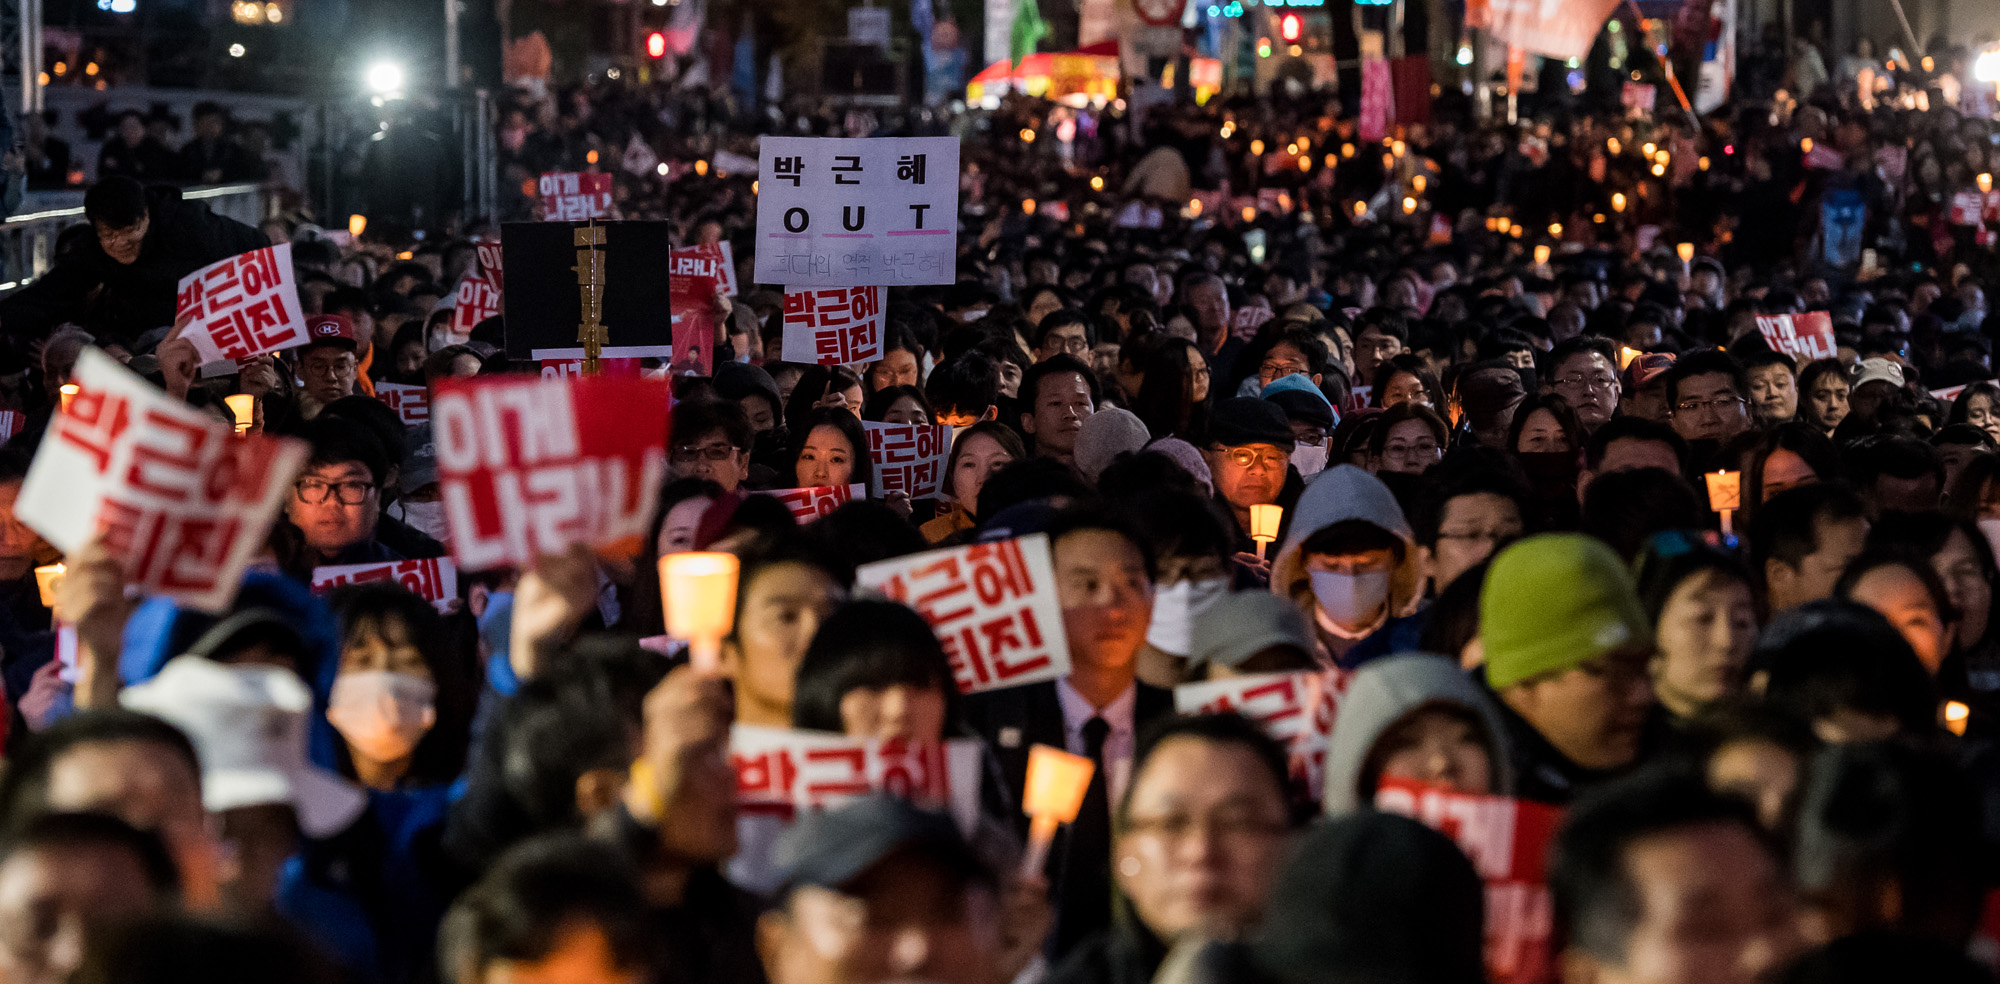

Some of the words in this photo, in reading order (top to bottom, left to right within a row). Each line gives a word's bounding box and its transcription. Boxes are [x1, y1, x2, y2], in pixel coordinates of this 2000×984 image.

[540, 174, 580, 196] 이게
[176, 246, 282, 322] 박근혜
[883, 252, 945, 279] 박근혜
[206, 292, 297, 360] 퇴진
[785, 286, 879, 328] 박근혜
[815, 320, 878, 365] 퇴진
[435, 378, 579, 472] 이게
